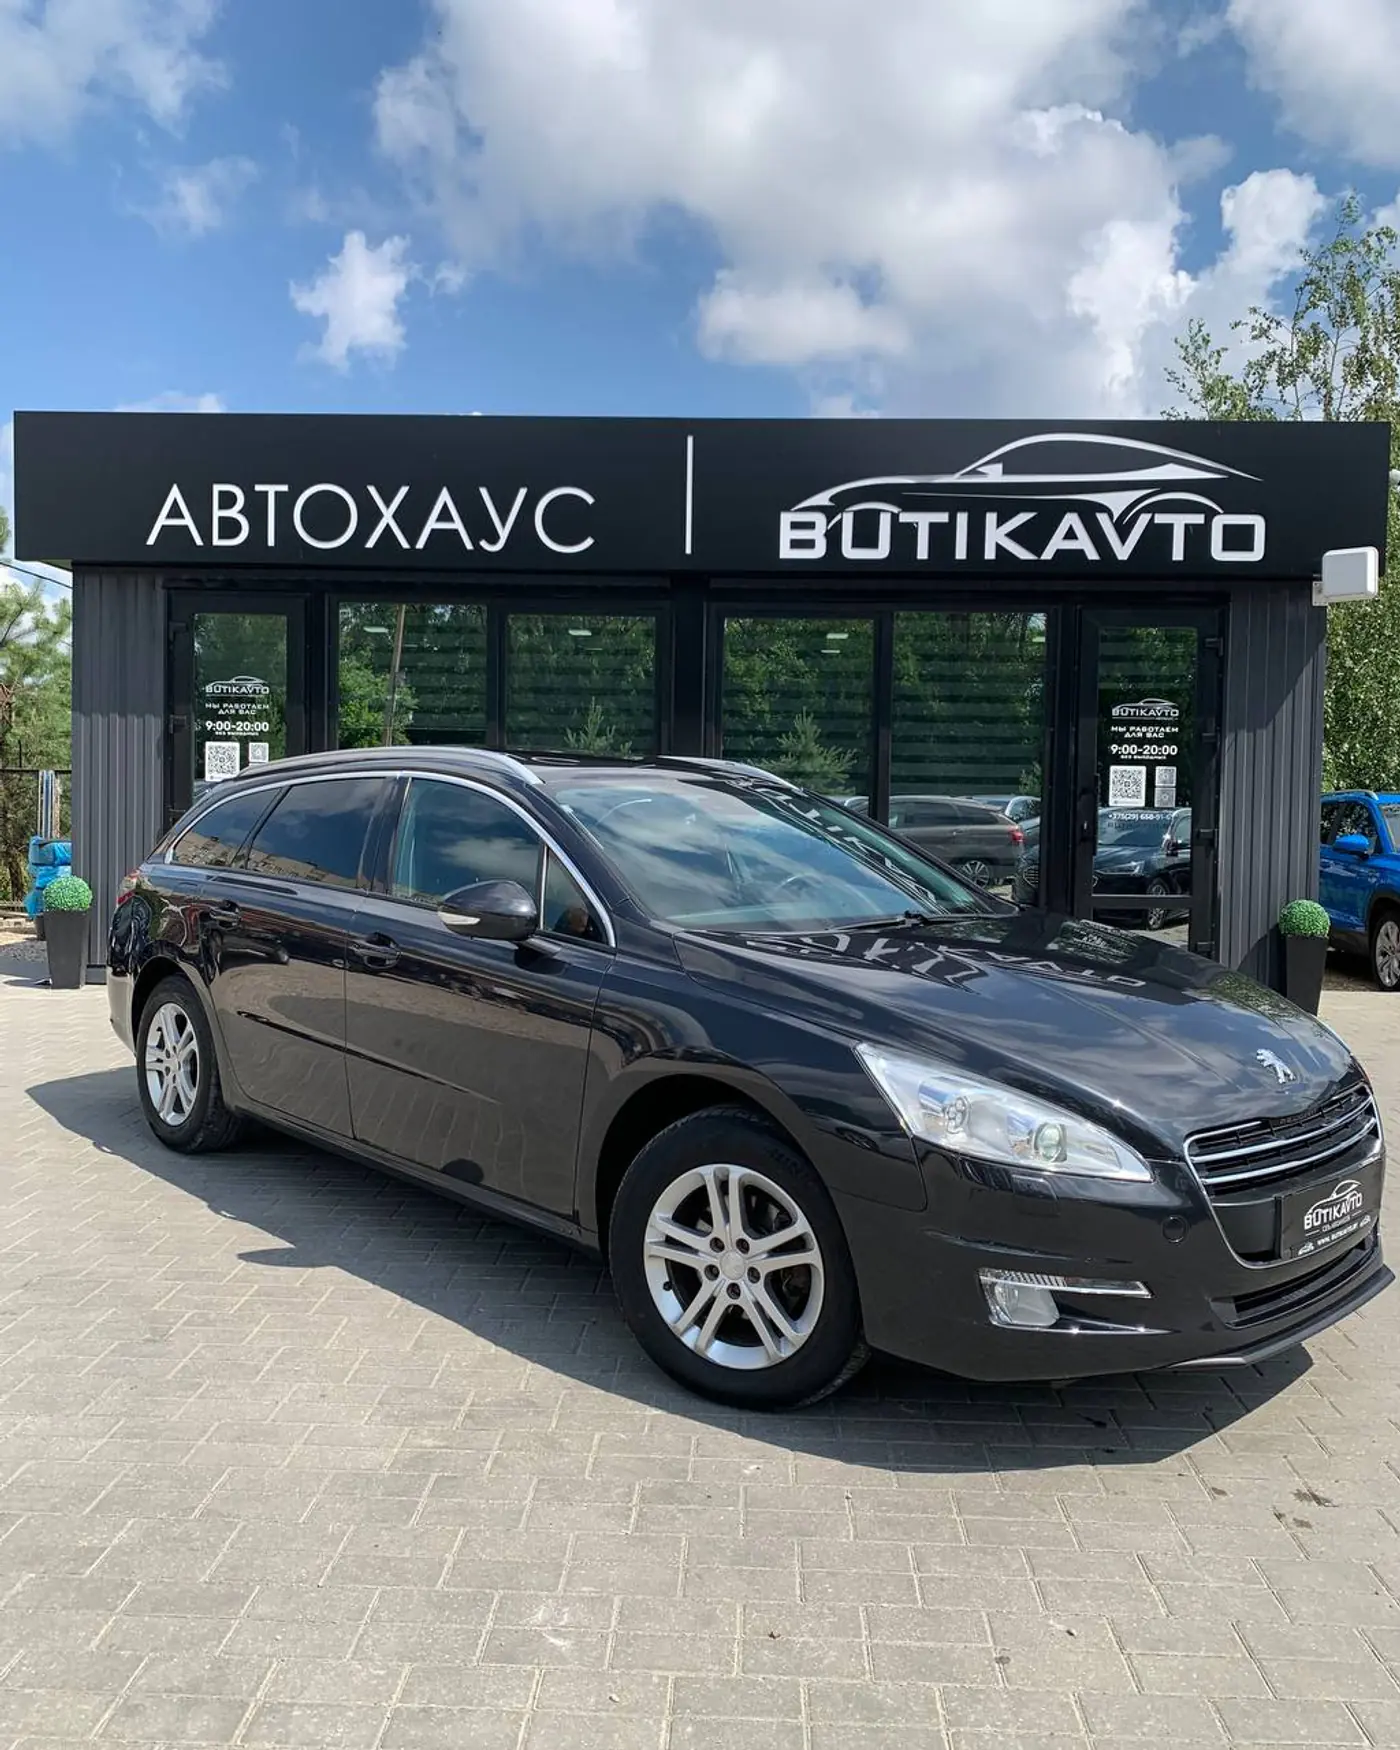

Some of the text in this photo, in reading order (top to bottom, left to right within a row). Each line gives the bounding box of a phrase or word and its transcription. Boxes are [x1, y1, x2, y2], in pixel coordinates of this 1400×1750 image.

[146, 482, 596, 554] АВТОХАУС
[779, 510, 1267, 562] BUTIKAVTO
[205, 685, 270, 695] BUTIKAVTO
[1111, 707, 1179, 717] BUTIKAVTO
[205, 720, 269, 732] 9:00-20:00
[1110, 744, 1179, 755] 9:00-20:00
[1304, 1193, 1363, 1231] BUTIKAVTO
